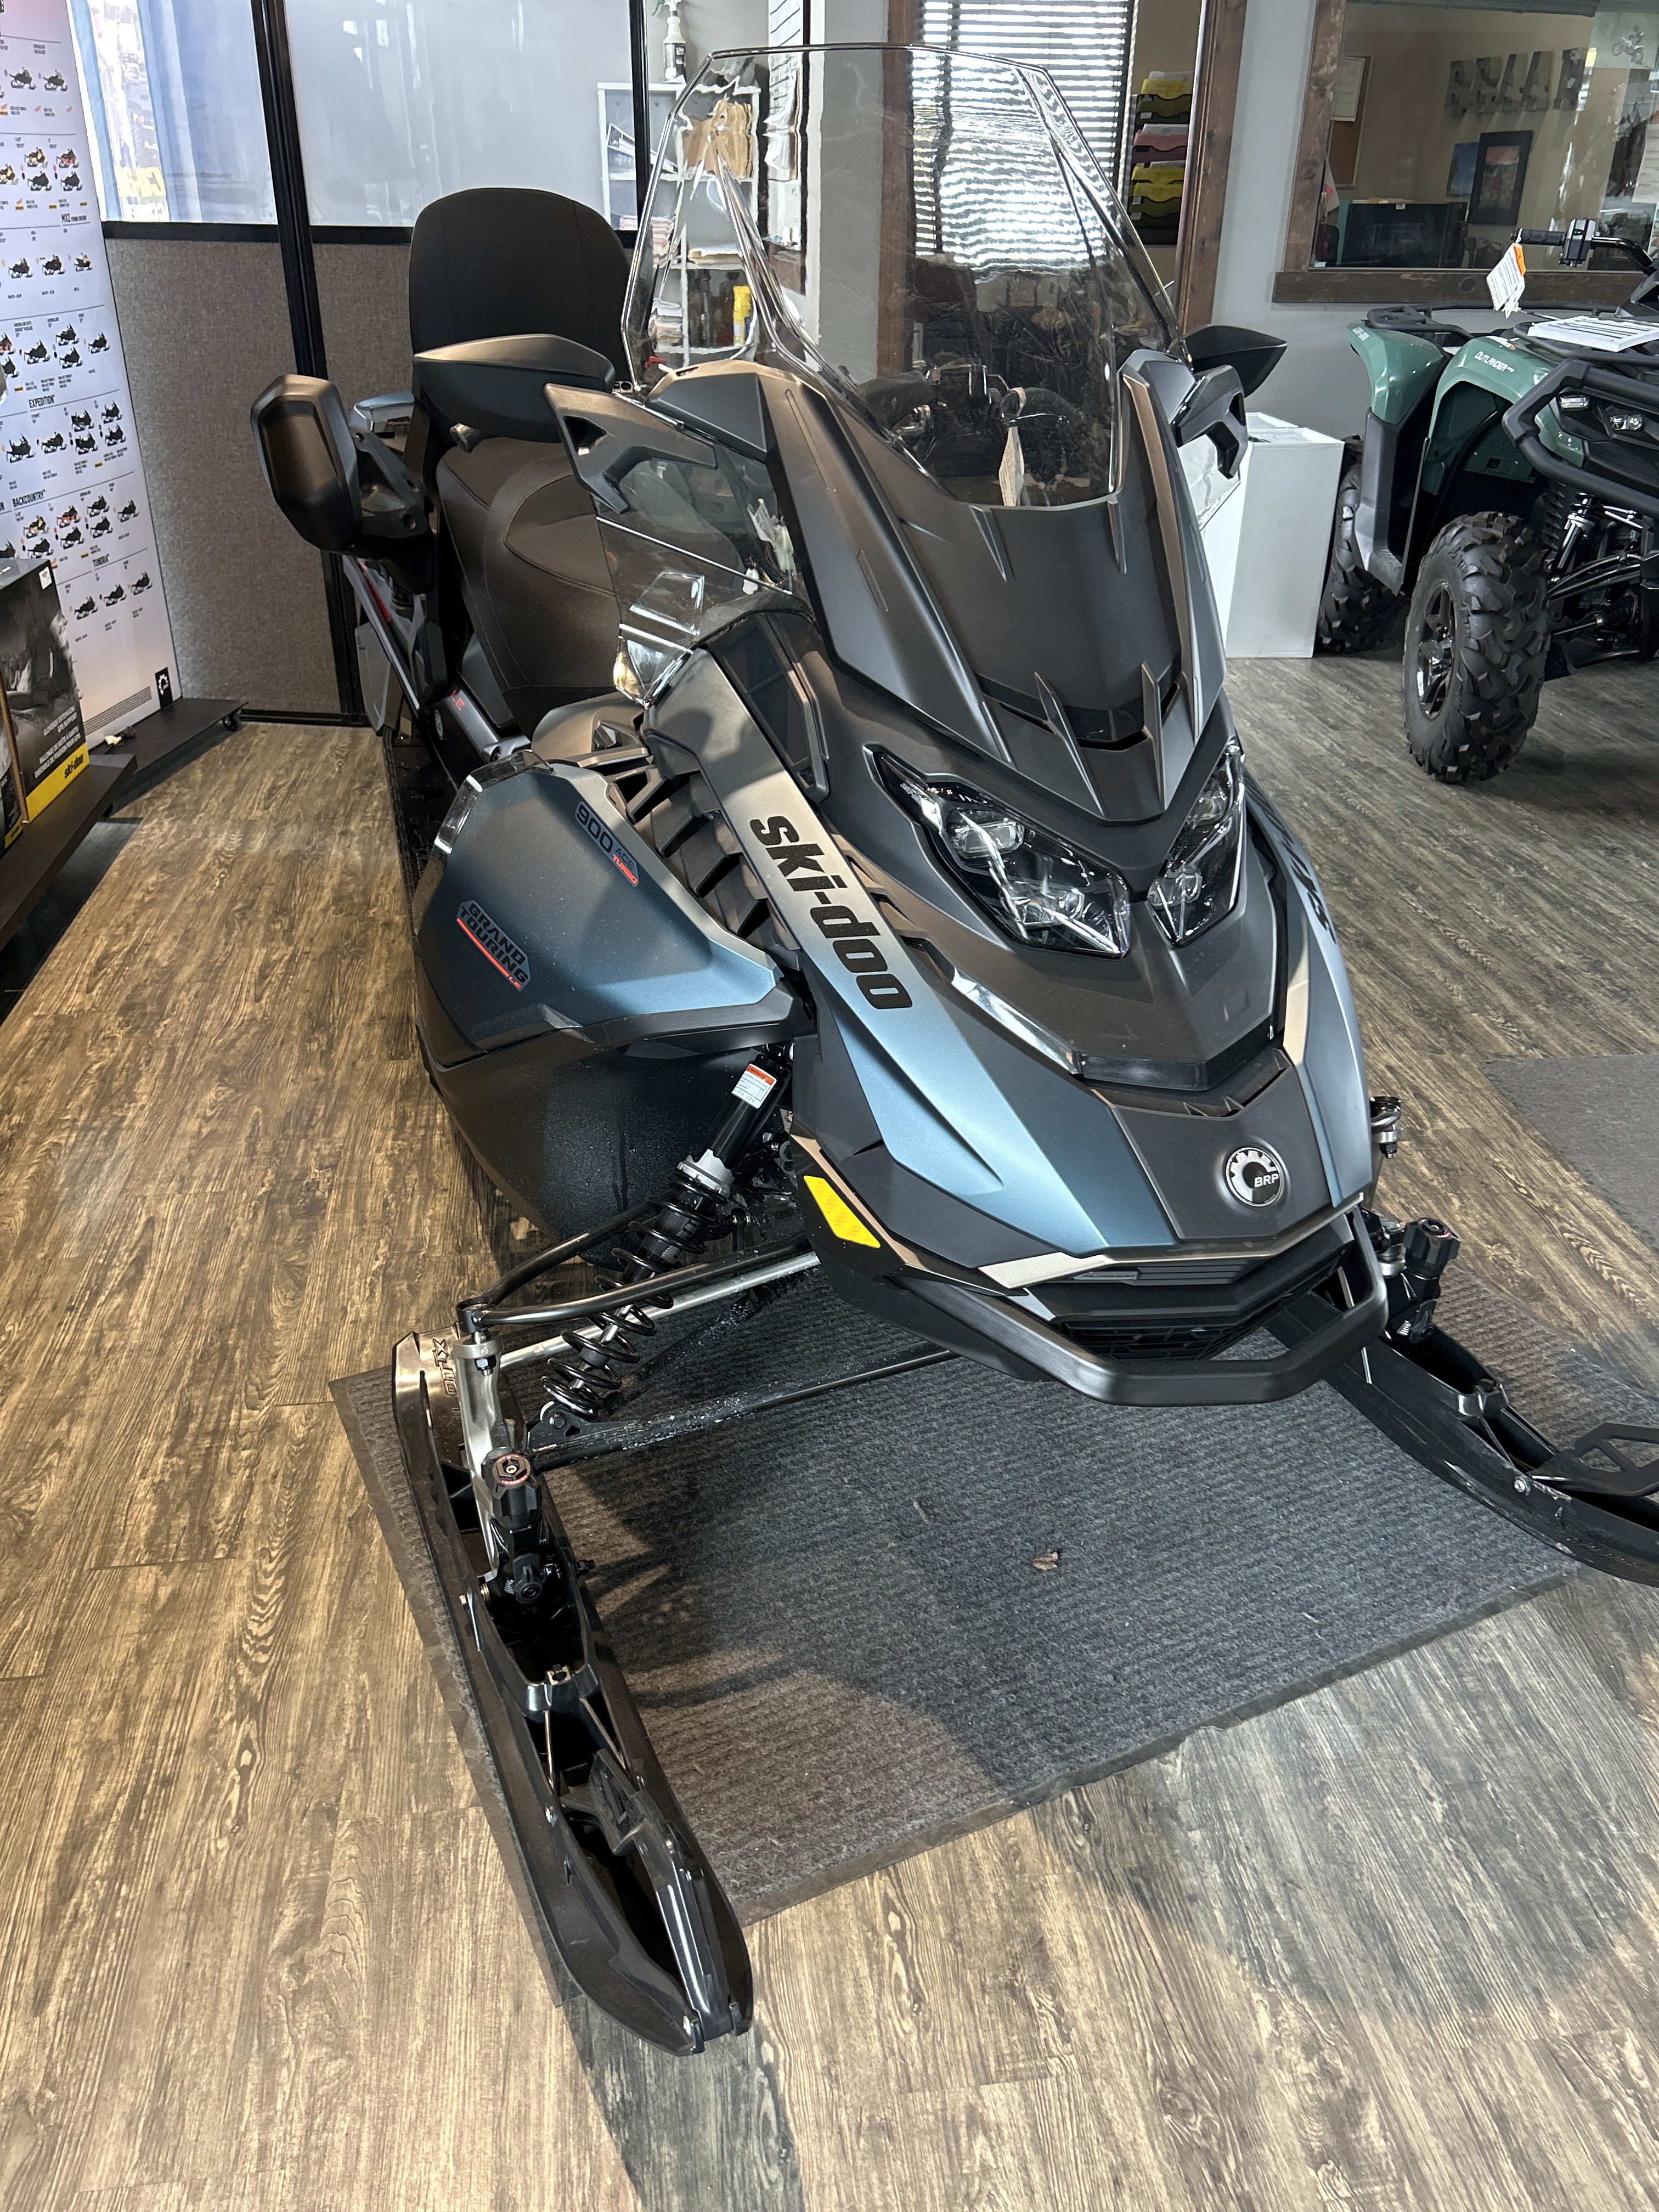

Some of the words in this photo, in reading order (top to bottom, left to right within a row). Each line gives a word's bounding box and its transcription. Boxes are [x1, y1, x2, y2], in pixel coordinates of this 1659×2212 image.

[1474, 351, 1508, 371] OUTLANDER
[13, 490, 45, 507] BACKCOUNTRY
[576, 805, 613, 854] 900
[615, 848, 635, 871] ACE
[612, 853, 638, 885] TURBO
[468, 903, 527, 966] GRAND
[749, 815, 912, 1009] ski-doo
[460, 906, 528, 984] TOURING
[1254, 1173, 1279, 1188] BRP
